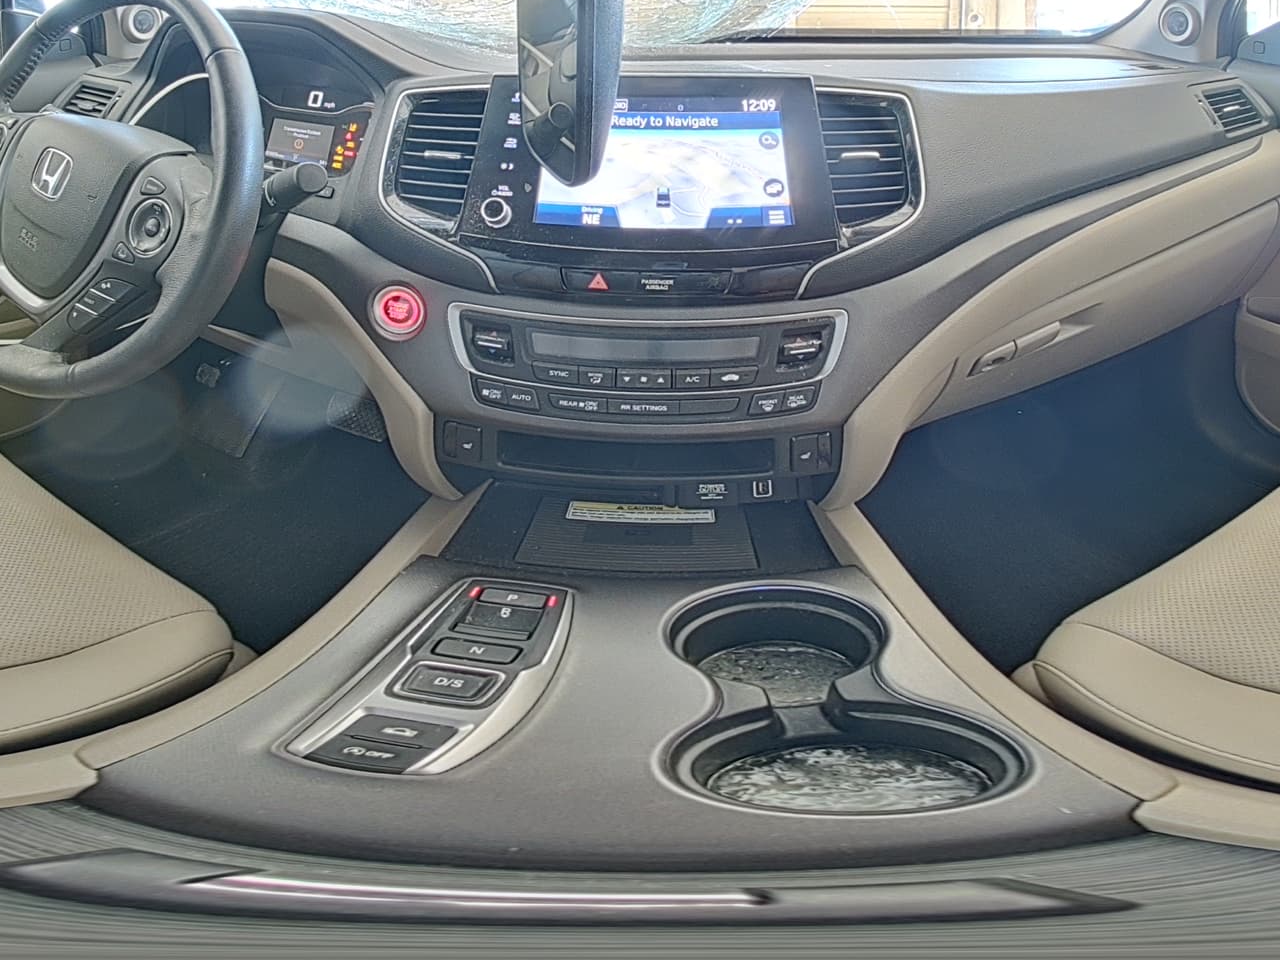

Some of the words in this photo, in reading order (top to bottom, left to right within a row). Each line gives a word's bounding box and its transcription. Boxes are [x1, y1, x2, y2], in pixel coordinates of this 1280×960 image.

[307, 91, 324, 108] 0
[741, 99, 777, 112] 12:09
[611, 116, 648, 128] Ready
[650, 116, 663, 127] to
[666, 116, 719, 128] Navigate
[582, 214, 601, 225] NE
[548, 370, 569, 378] SYNC
[512, 393, 532, 401] AUTO
[506, 594, 518, 602] P
[470, 646, 486, 655] N
[433, 676, 465, 689] D/S
[365, 750, 396, 759] OFF
